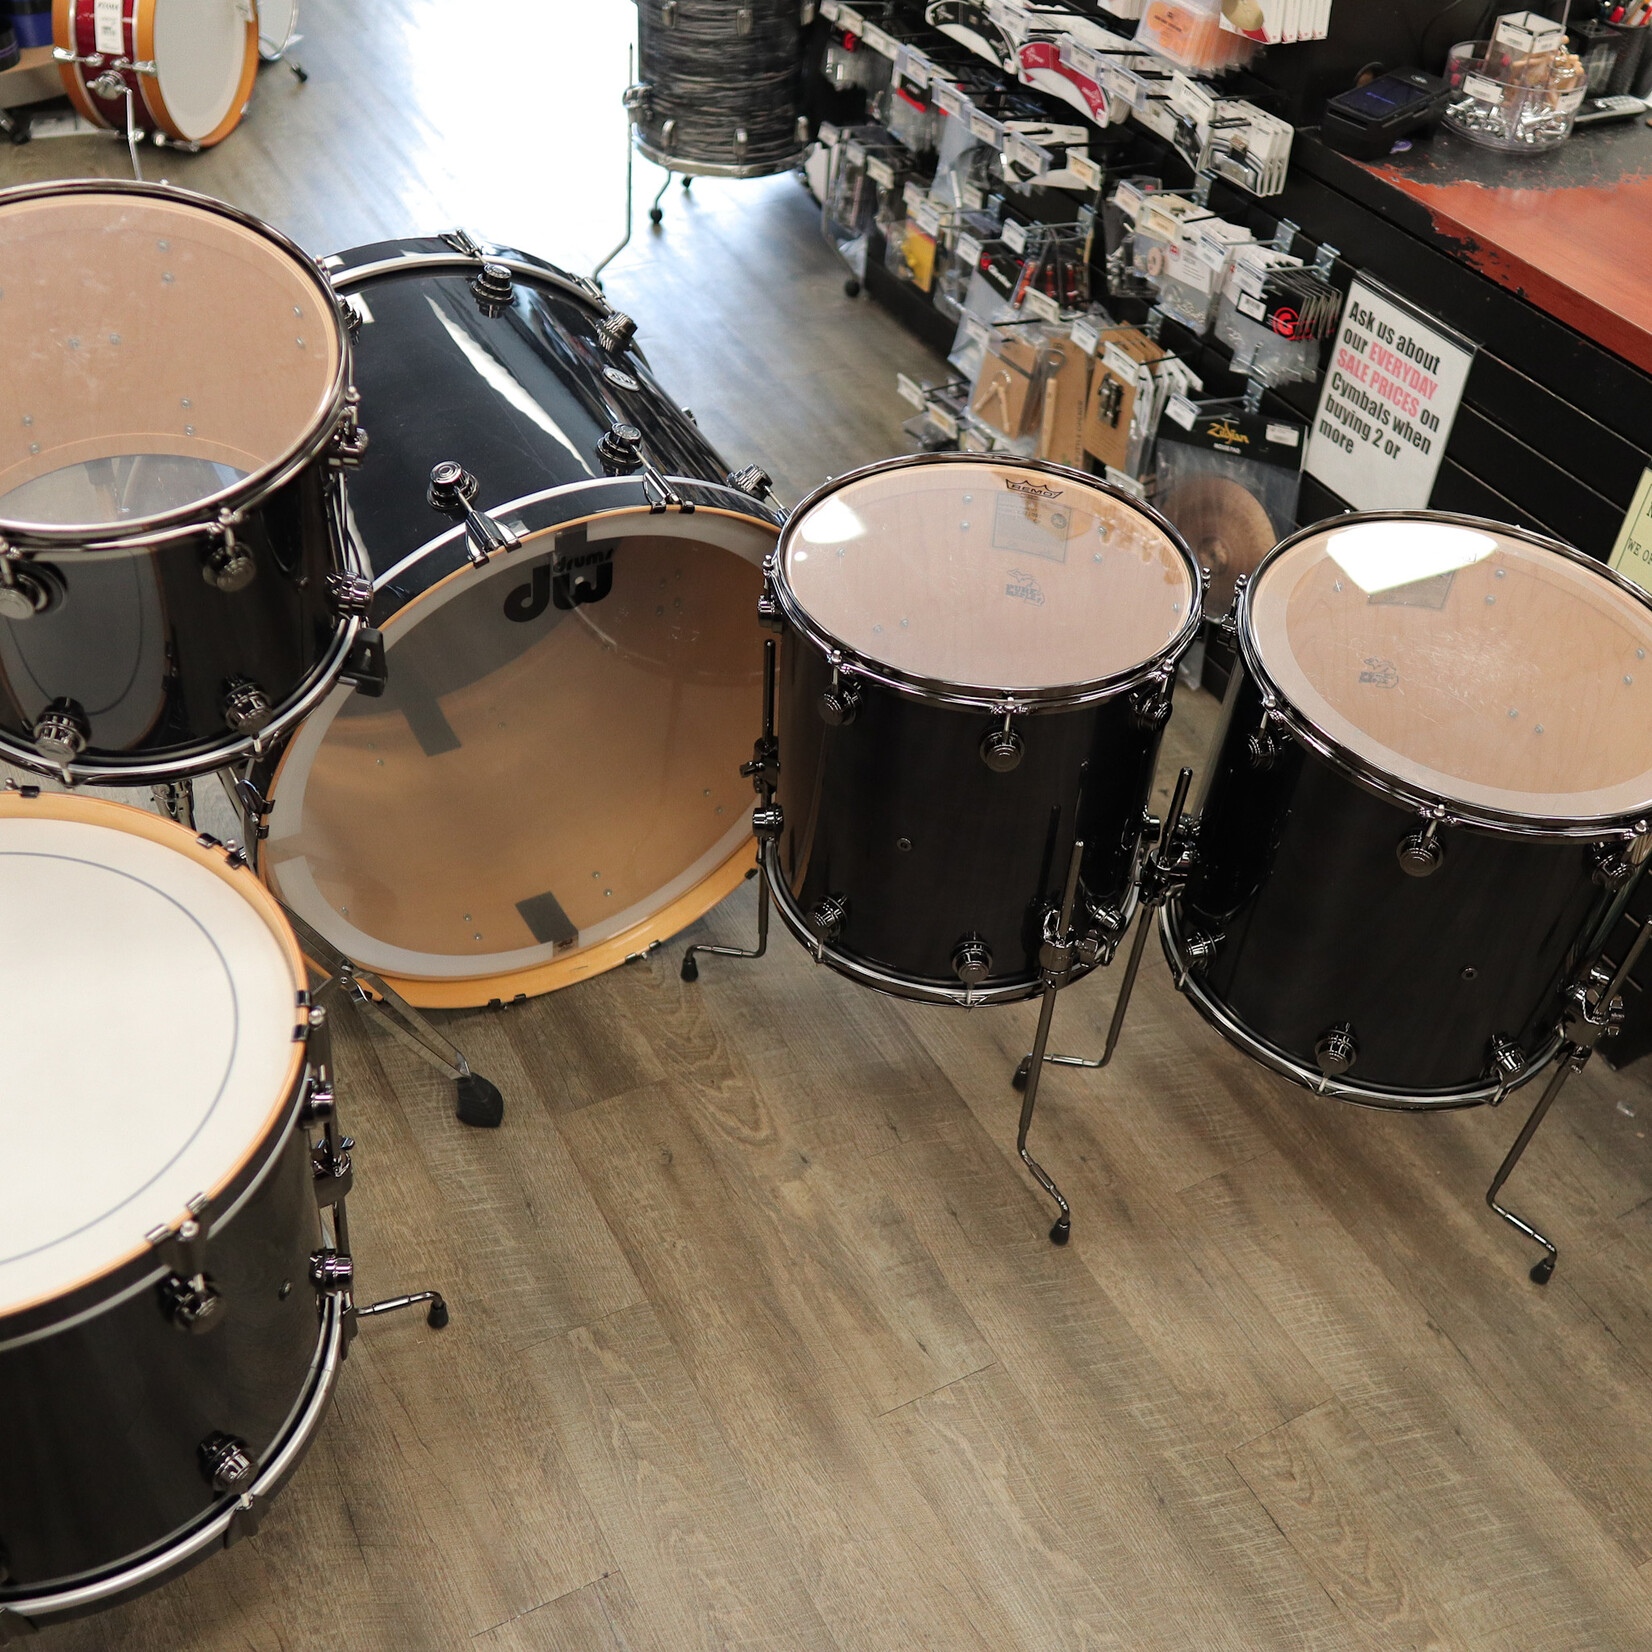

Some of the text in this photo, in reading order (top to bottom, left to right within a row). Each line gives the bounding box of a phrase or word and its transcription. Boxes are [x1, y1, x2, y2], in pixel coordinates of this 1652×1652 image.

[1343, 328, 1438, 400] our EVERYDAY
[1349, 301, 1440, 375] Ask us about
[1332, 371, 1432, 455] Cymbals when
[1337, 348, 1440, 433] SALE PRICES on
[1319, 418, 1354, 454] more
[1325, 393, 1401, 460] buying 2 or
[1008, 483, 1058, 498] REMO
[1627, 538, 1641, 556] WE
[504, 562, 613, 622] dw
